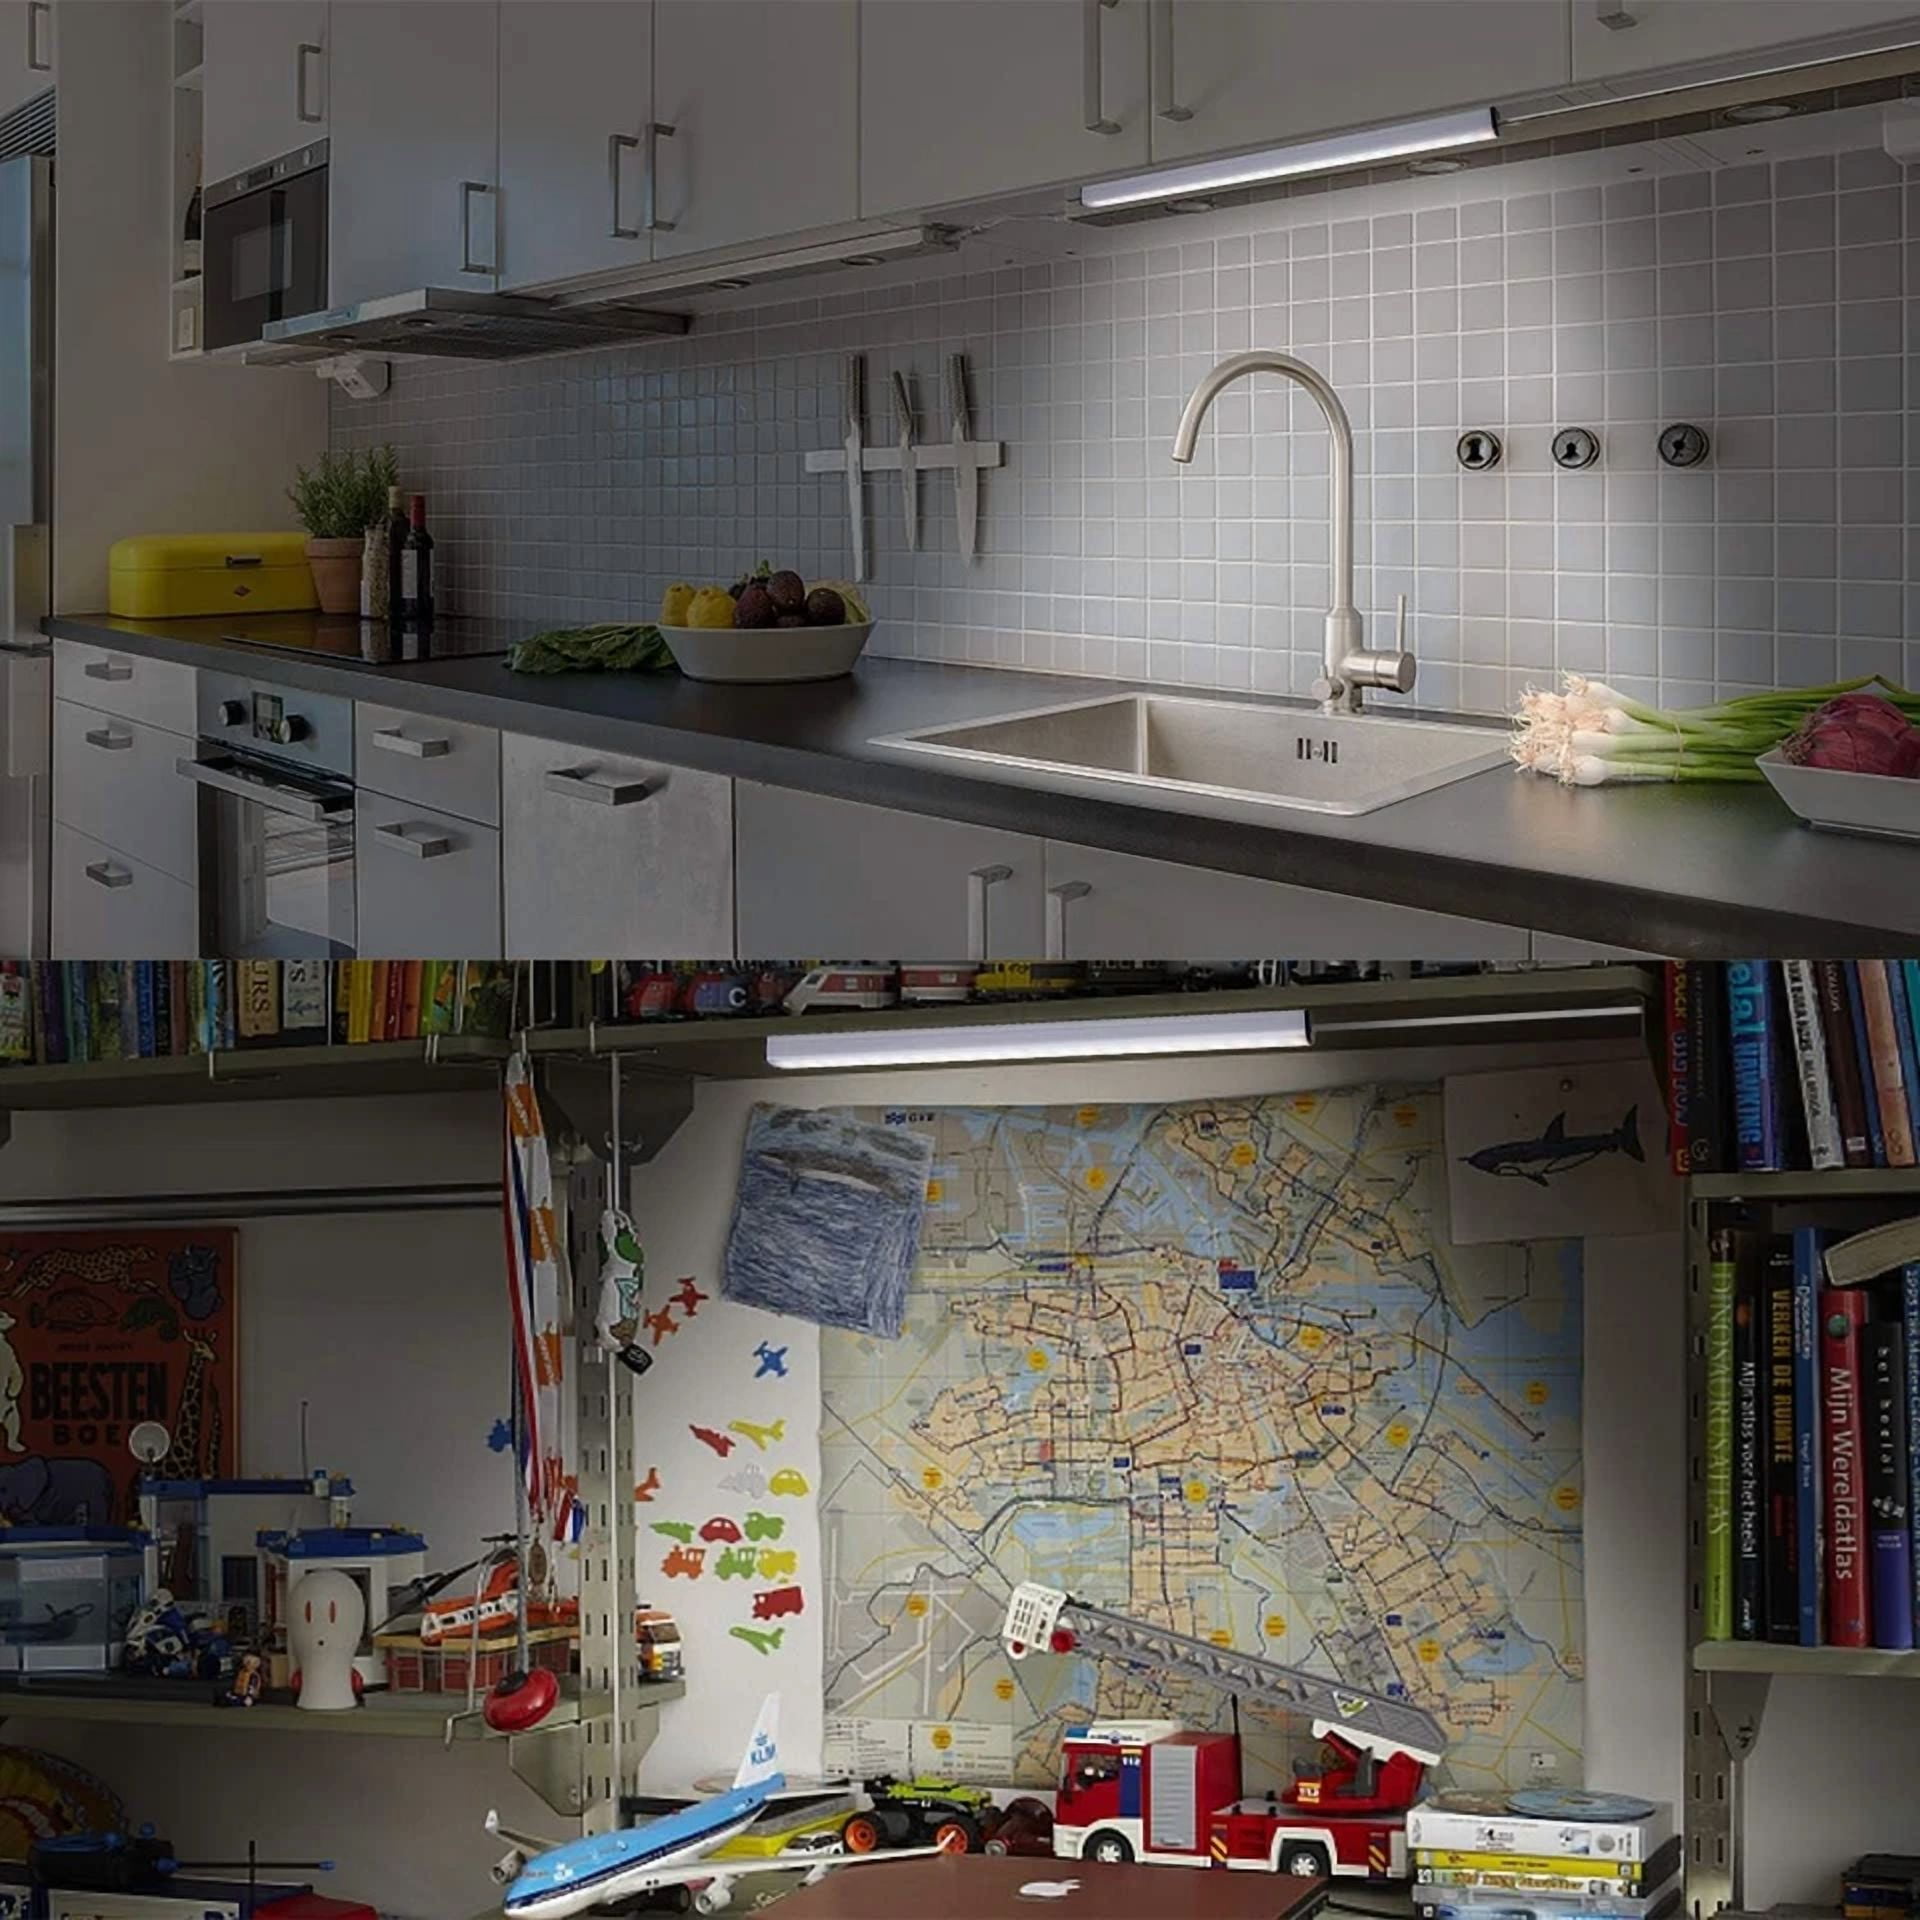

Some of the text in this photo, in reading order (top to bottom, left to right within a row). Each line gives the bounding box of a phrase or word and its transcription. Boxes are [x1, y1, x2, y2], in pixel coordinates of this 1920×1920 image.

[728, 986, 747, 1008] C
[1733, 1041, 1762, 1143] HAWKING
[1772, 1289, 1792, 1358] VERKEN
[30, 1362, 168, 1421] BEESTEN
[1772, 1364, 1792, 1387] DE
[1877, 1346, 1890, 1383] het
[1708, 1272, 1733, 1535] DINOSAURUSATLAS
[1773, 1395, 1794, 1463] RUIMTE
[1741, 1480, 1757, 1507] het
[1826, 1367, 1857, 1579] Mijn Wereldatlas
